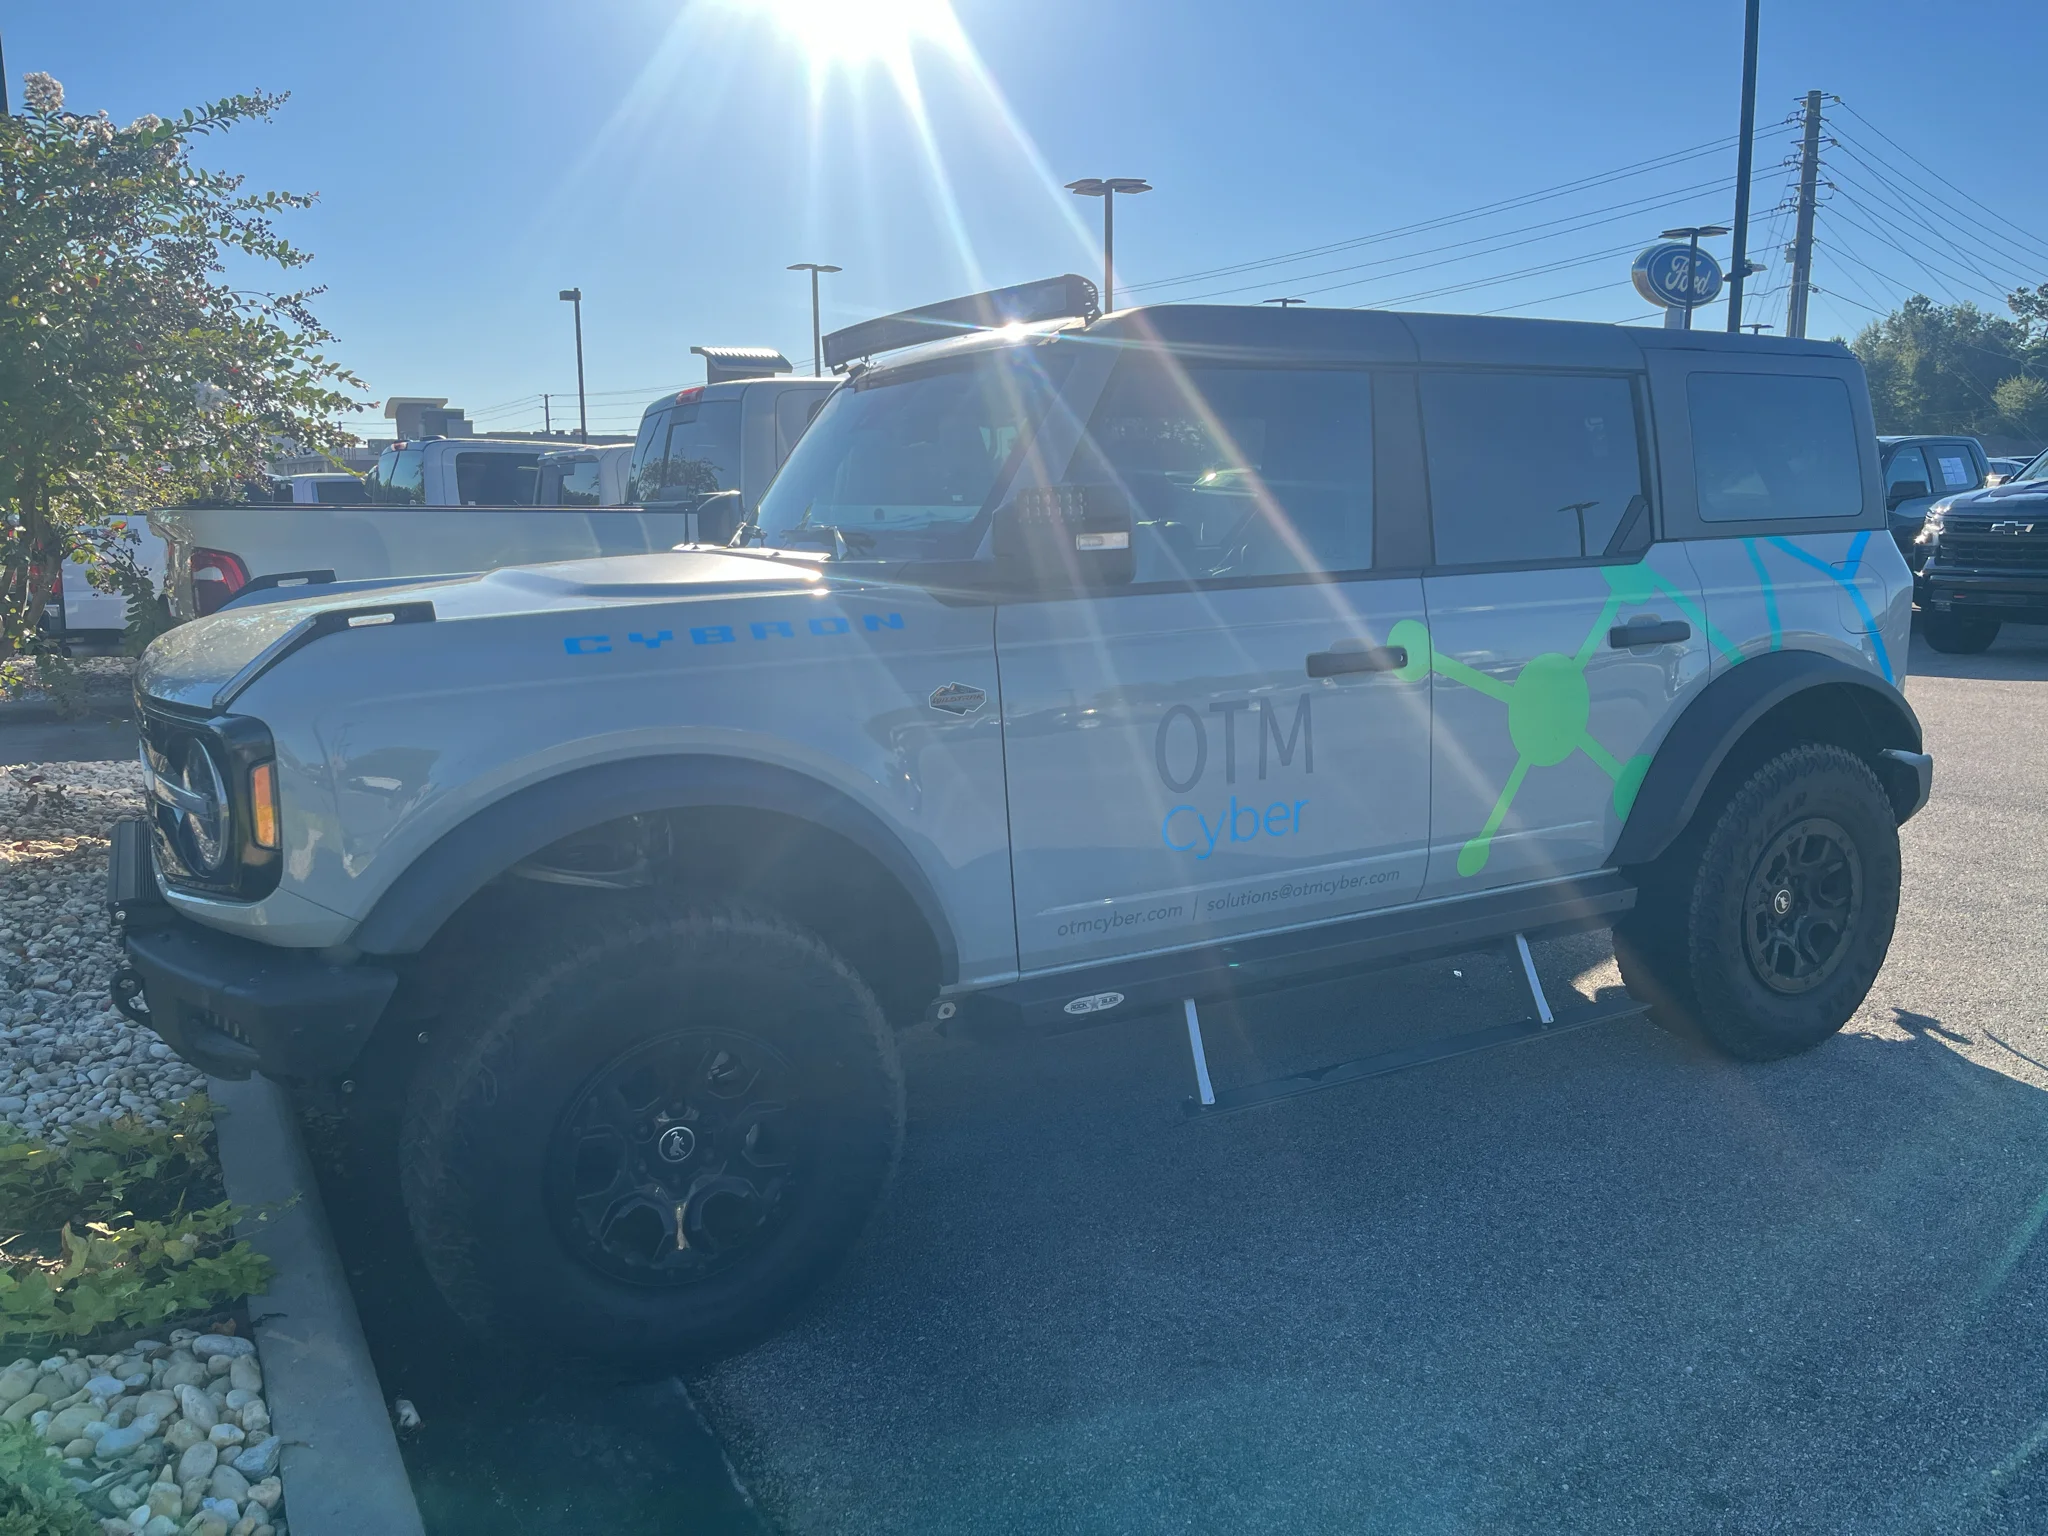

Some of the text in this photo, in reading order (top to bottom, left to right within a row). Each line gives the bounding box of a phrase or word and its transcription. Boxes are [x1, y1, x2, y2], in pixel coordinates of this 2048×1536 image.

[564, 613, 905, 655] CYBRON
[1155, 693, 1313, 793] OTM
[1162, 795, 1310, 860] Cyber
[1057, 870, 1400, 936] otmcyber.com solutions@otmcyber.com
